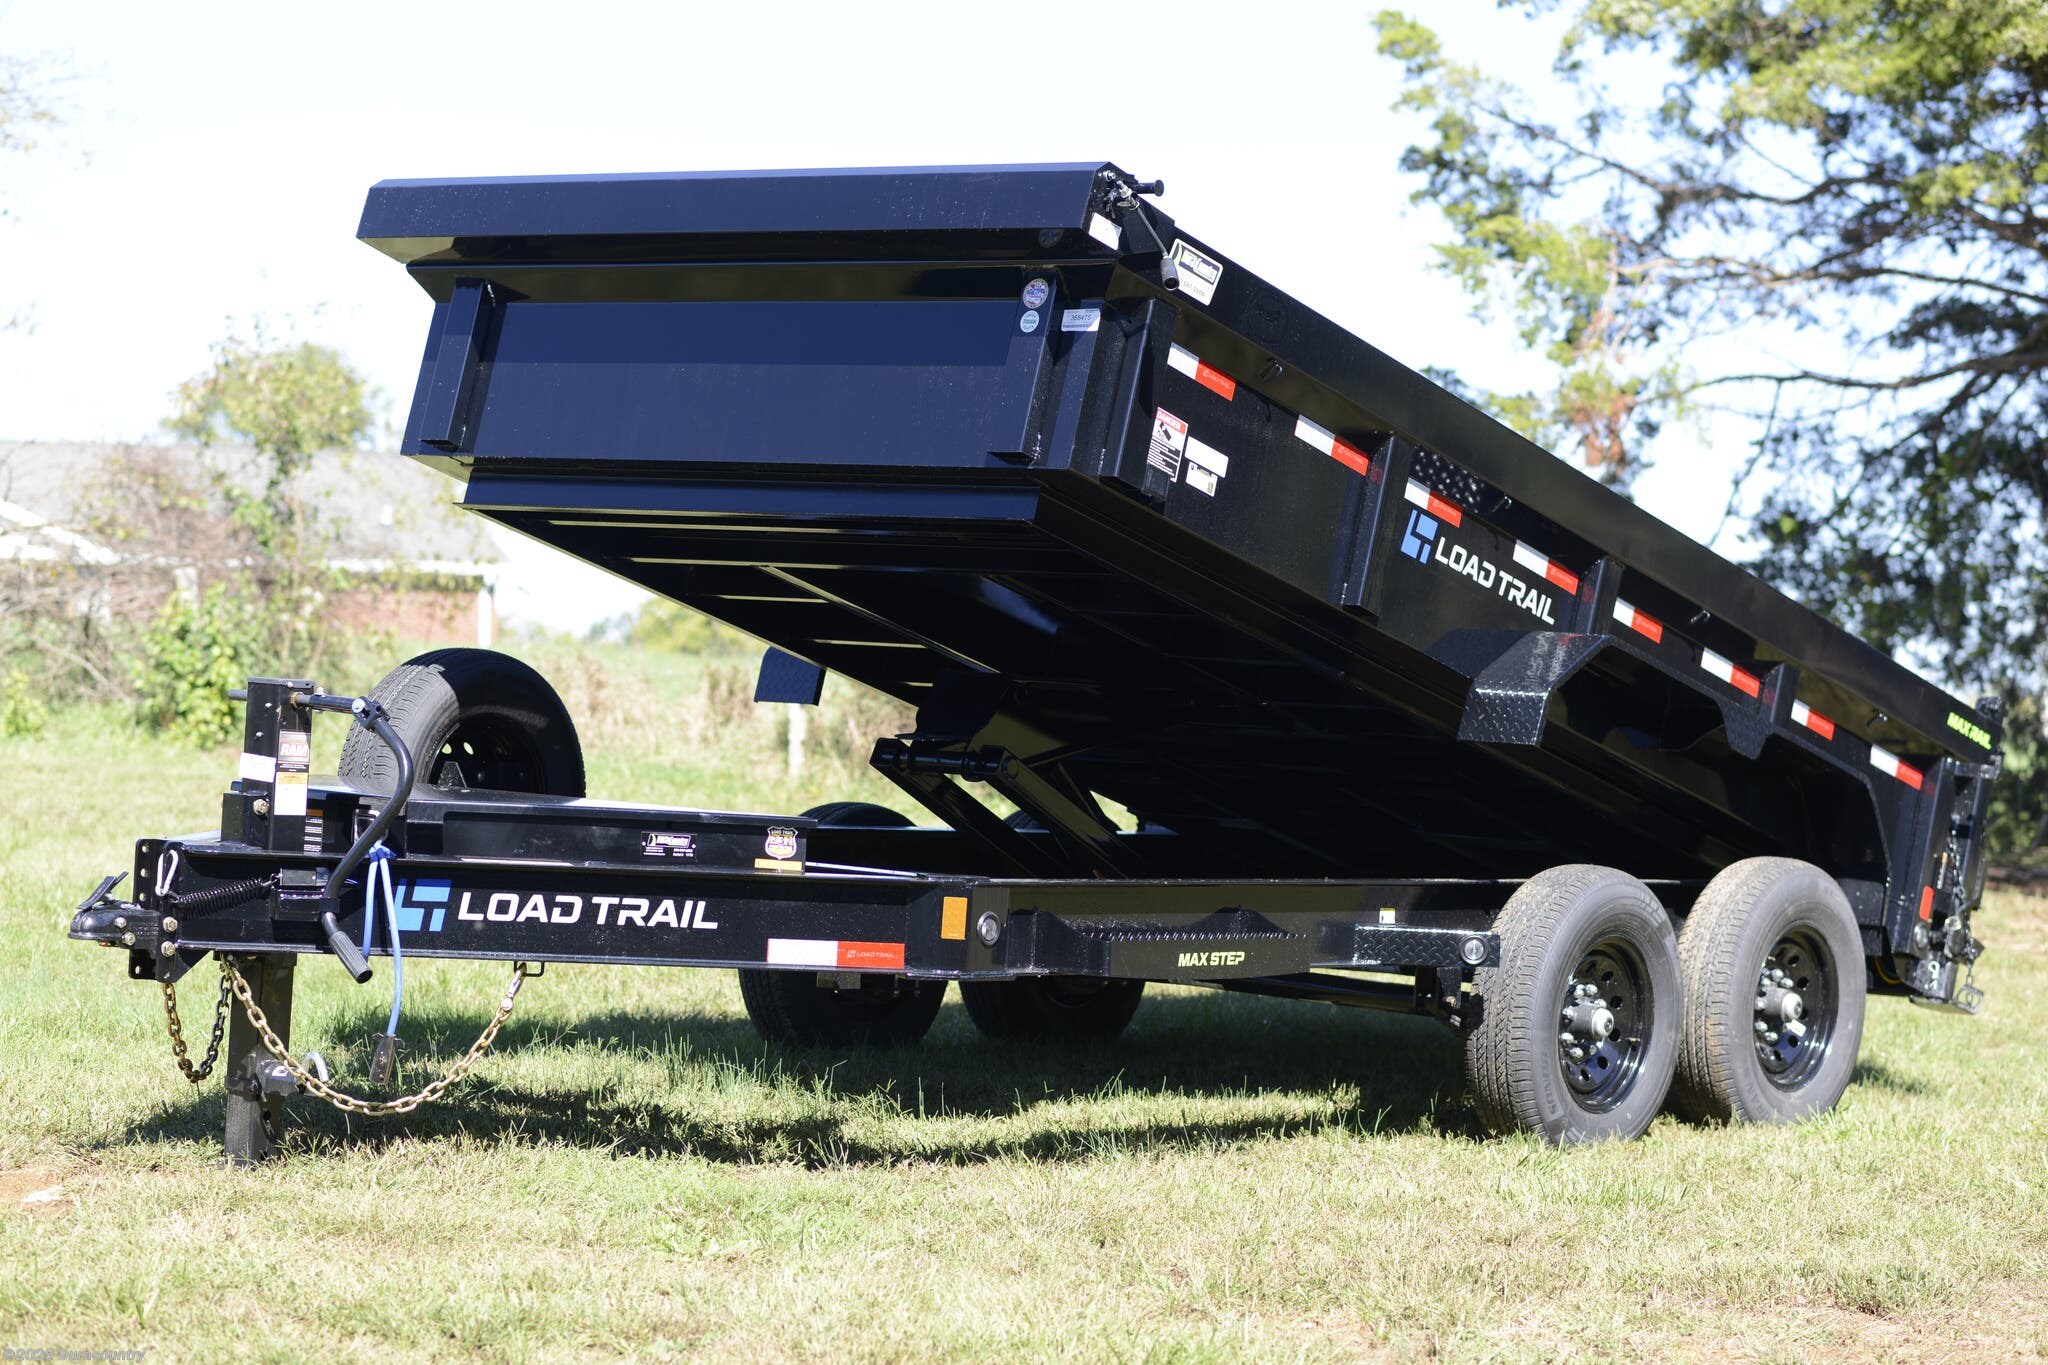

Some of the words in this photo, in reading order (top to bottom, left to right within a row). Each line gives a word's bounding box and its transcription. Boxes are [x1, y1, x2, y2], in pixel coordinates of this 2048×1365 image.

[1435, 536, 1496, 588] LOAD
[1499, 570, 1555, 625] TRAIL
[1947, 711, 1972, 737] MAX
[280, 743, 309, 757] RAM
[458, 891, 583, 923] LOAD
[592, 896, 718, 929] TRAIL
[1178, 952, 1209, 967] MAX
[1210, 951, 1245, 966] STEP
